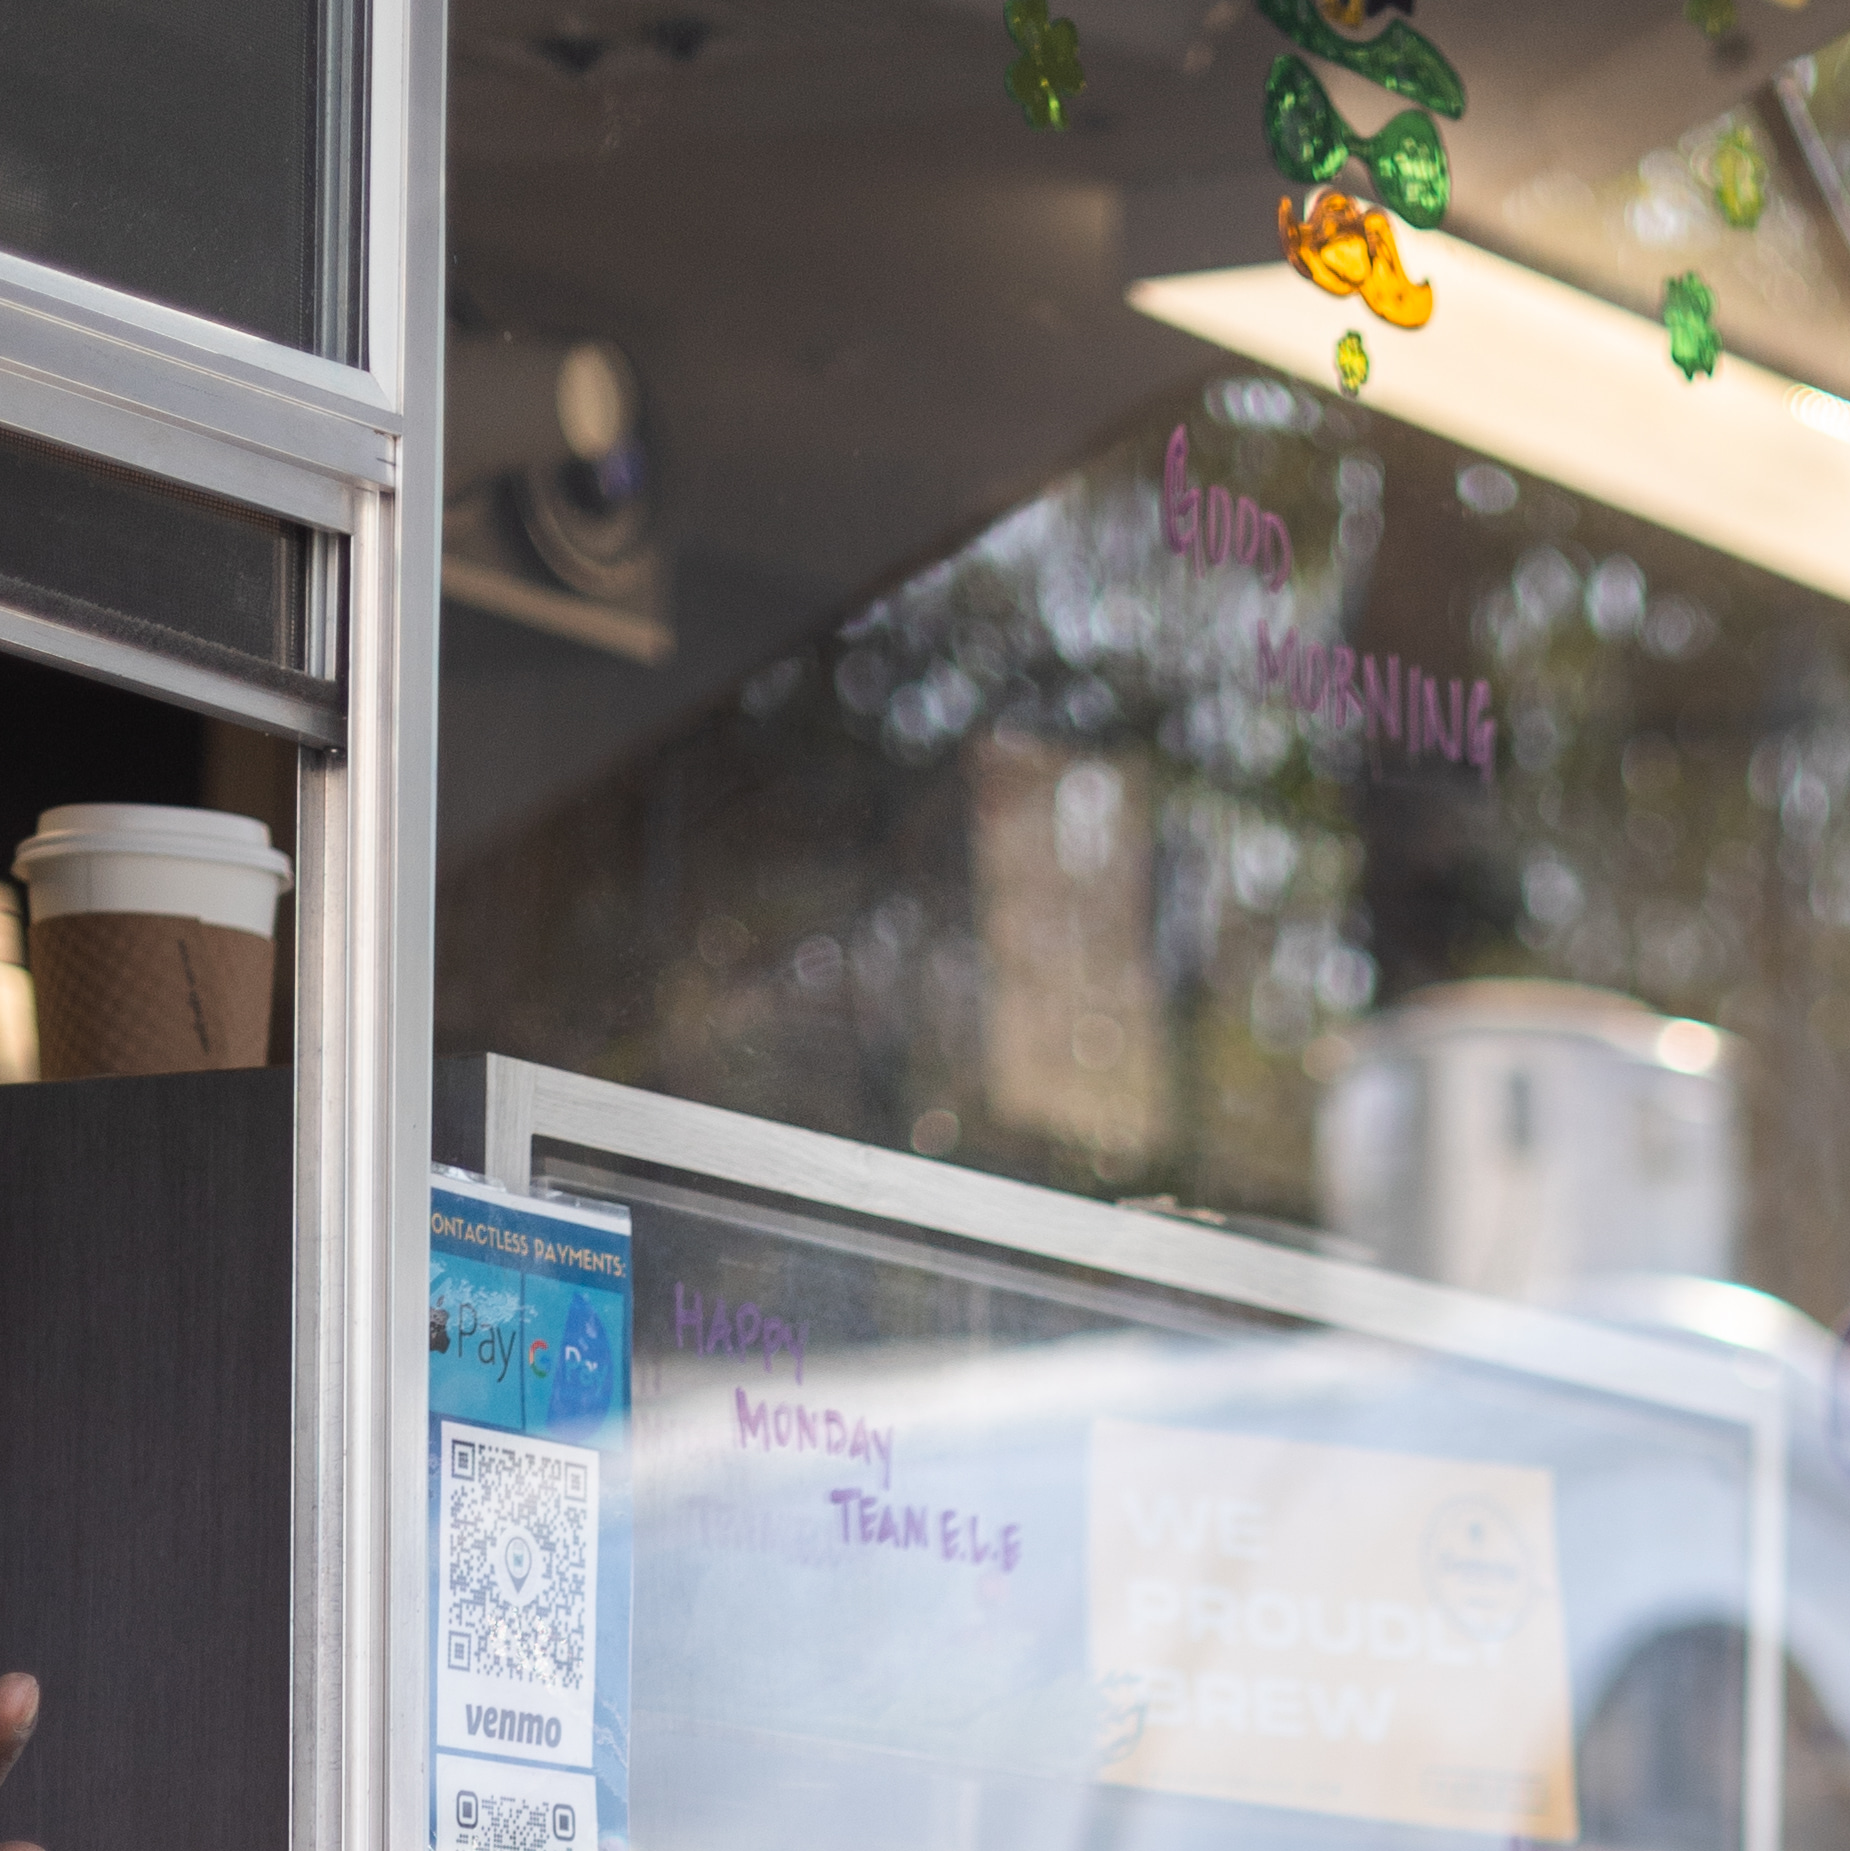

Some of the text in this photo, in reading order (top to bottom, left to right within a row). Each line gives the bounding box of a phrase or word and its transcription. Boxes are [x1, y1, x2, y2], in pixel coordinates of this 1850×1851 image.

[1165, 424, 1292, 594] GOOD
[1258, 619, 1496, 783] MORNING
[431, 1212, 627, 1278] ONTACTLESS PAYMENTS:
[457, 1302, 516, 1383] Pay
[674, 1281, 808, 1386] HAPPY
[735, 1386, 893, 1491] MONDAY
[464, 1702, 563, 1750] venmo
